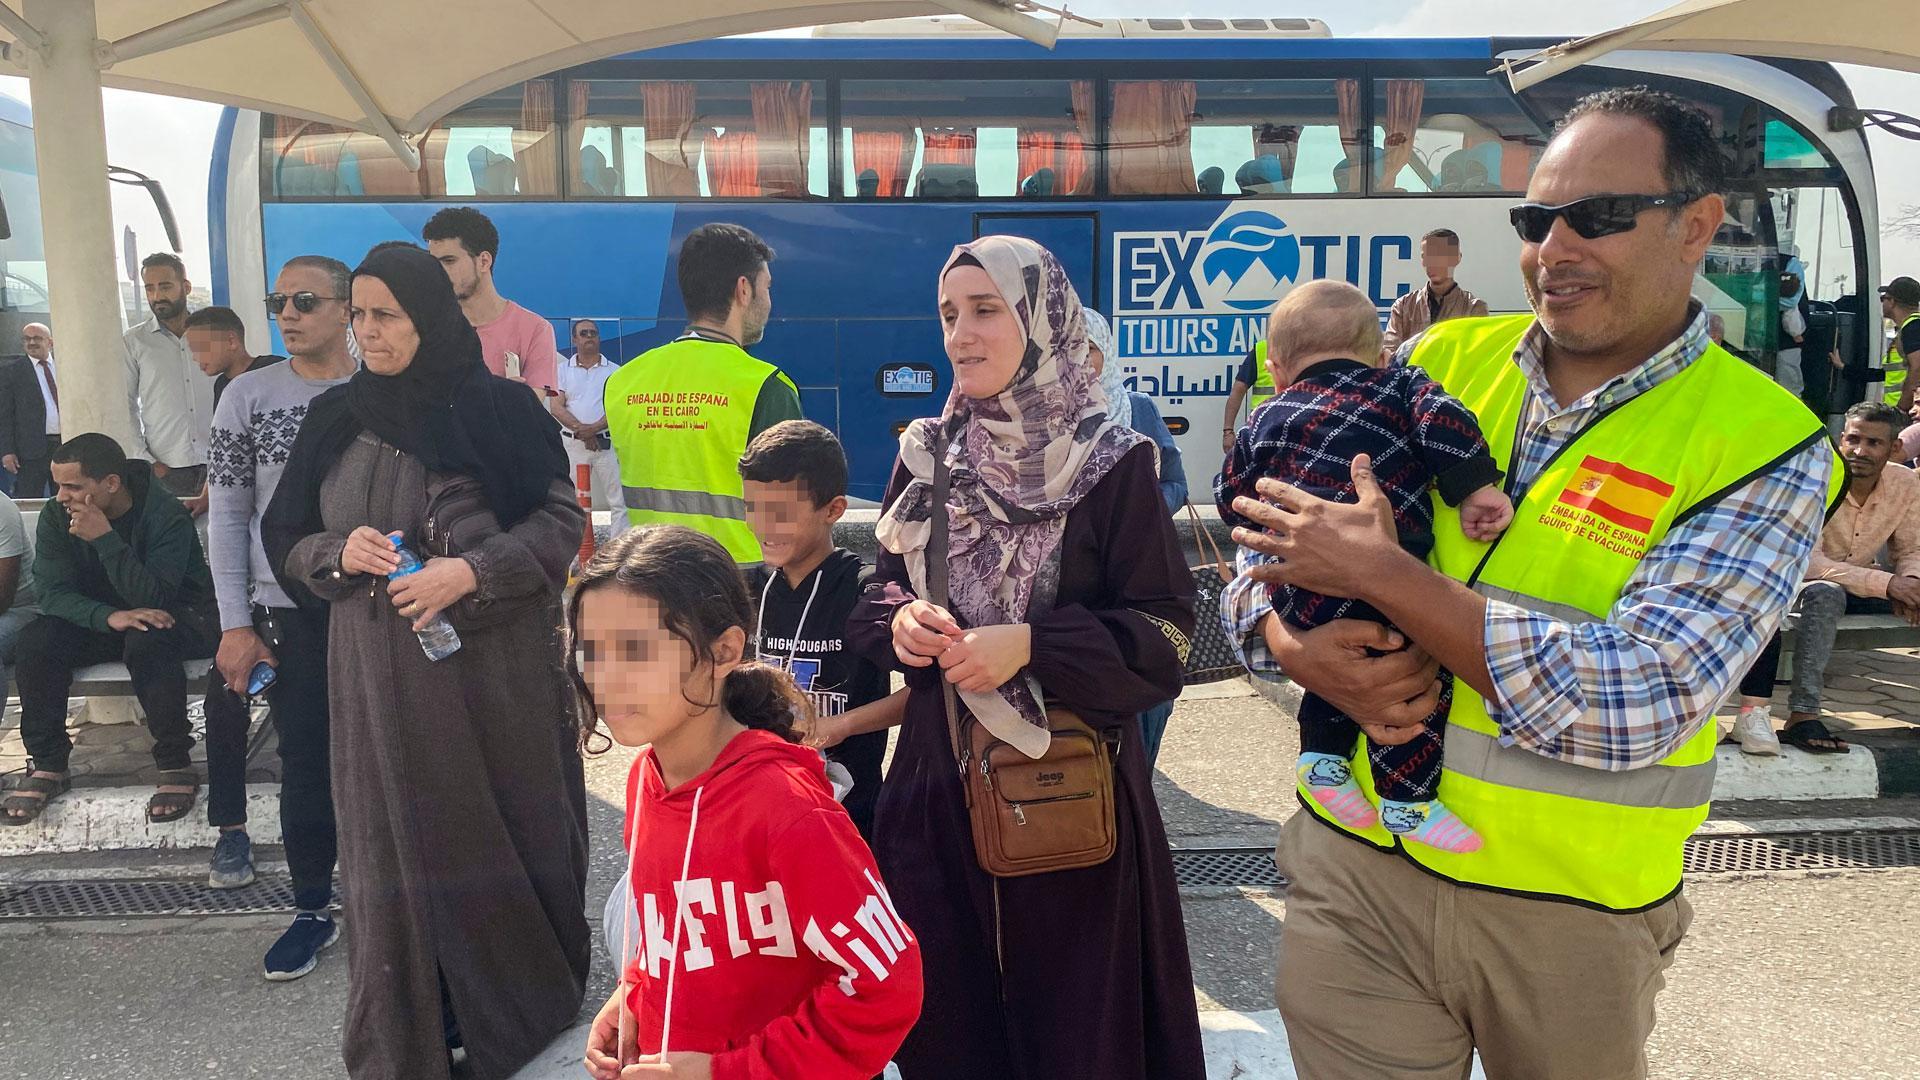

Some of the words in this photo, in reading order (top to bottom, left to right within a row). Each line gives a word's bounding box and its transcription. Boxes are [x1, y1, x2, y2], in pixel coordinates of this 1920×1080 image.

[1122, 318, 1219, 355] TOURS
[1228, 317, 1267, 353] AN
[1122, 364, 1242, 404] لسياحة
[627, 393, 674, 406] EMBAJADA
[676, 392, 688, 404] DE
[646, 406, 659, 416] EN
[662, 406, 674, 417] EL
[675, 406, 700, 417] CAIRO
[1538, 514, 1572, 532] EQUIPO
[1573, 525, 1587, 537] DE
[1550, 504, 1596, 527] EMBAJADA
[1597, 521, 1612, 535] DE
[1035, 771, 1065, 782] Jeep
